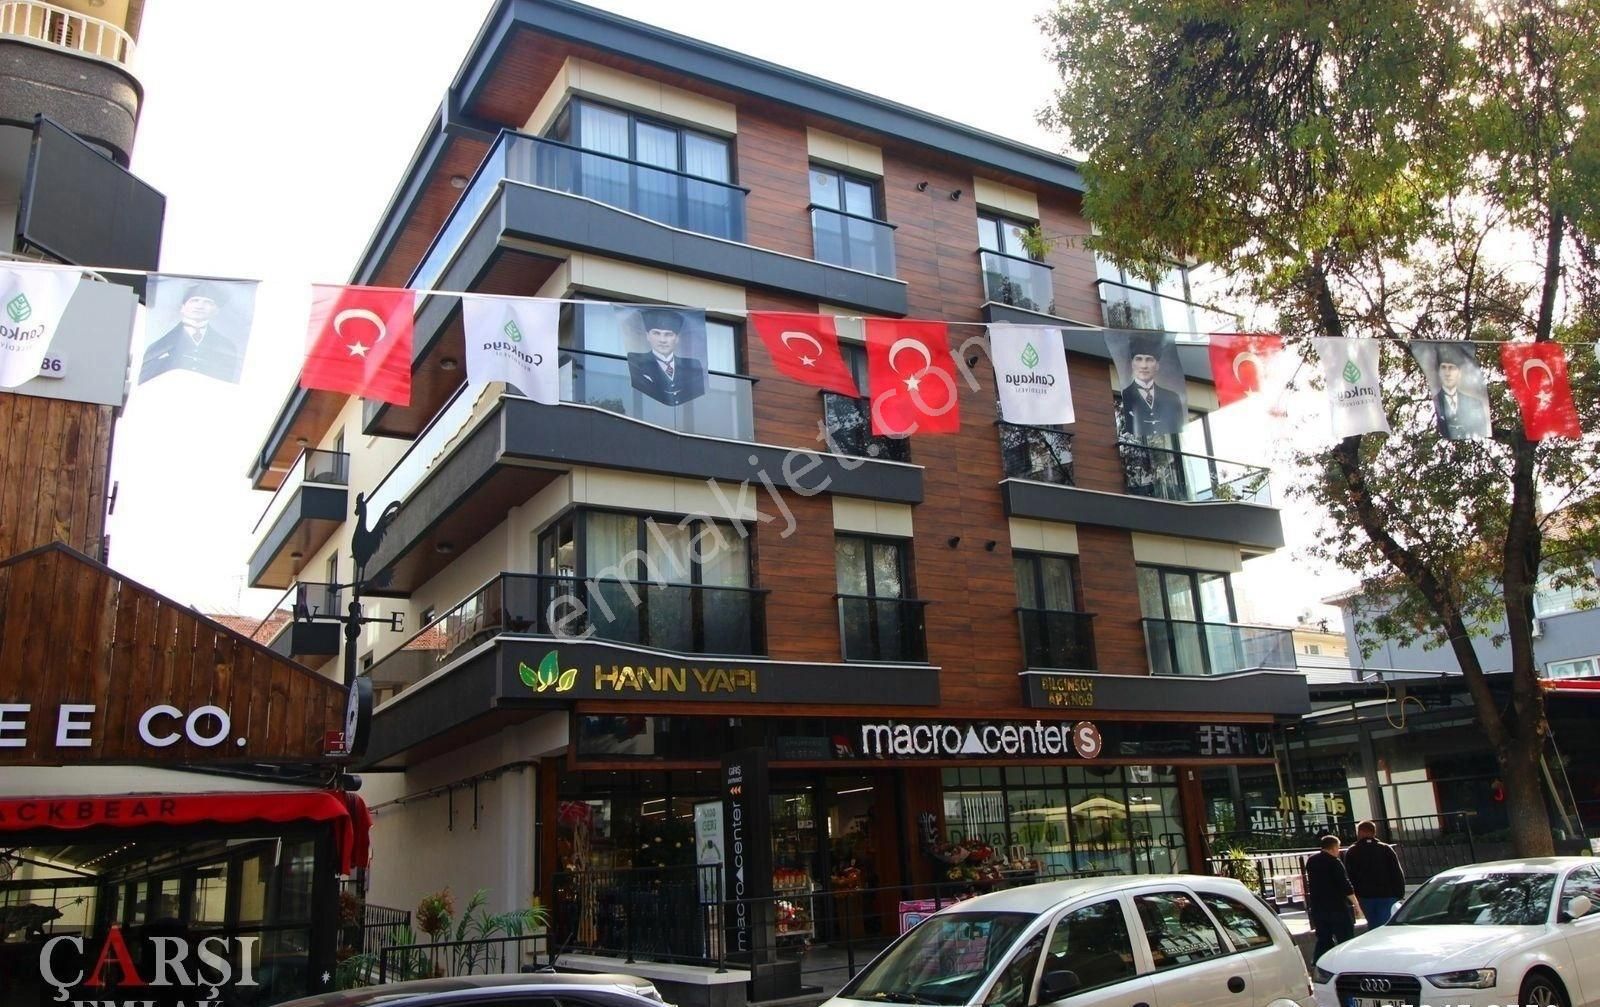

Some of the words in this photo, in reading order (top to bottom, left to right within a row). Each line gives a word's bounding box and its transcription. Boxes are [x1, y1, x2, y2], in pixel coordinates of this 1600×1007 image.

[594, 665, 687, 692] HANN
[692, 668, 757, 693] YAPI
[138, 704, 247, 747] CO.
